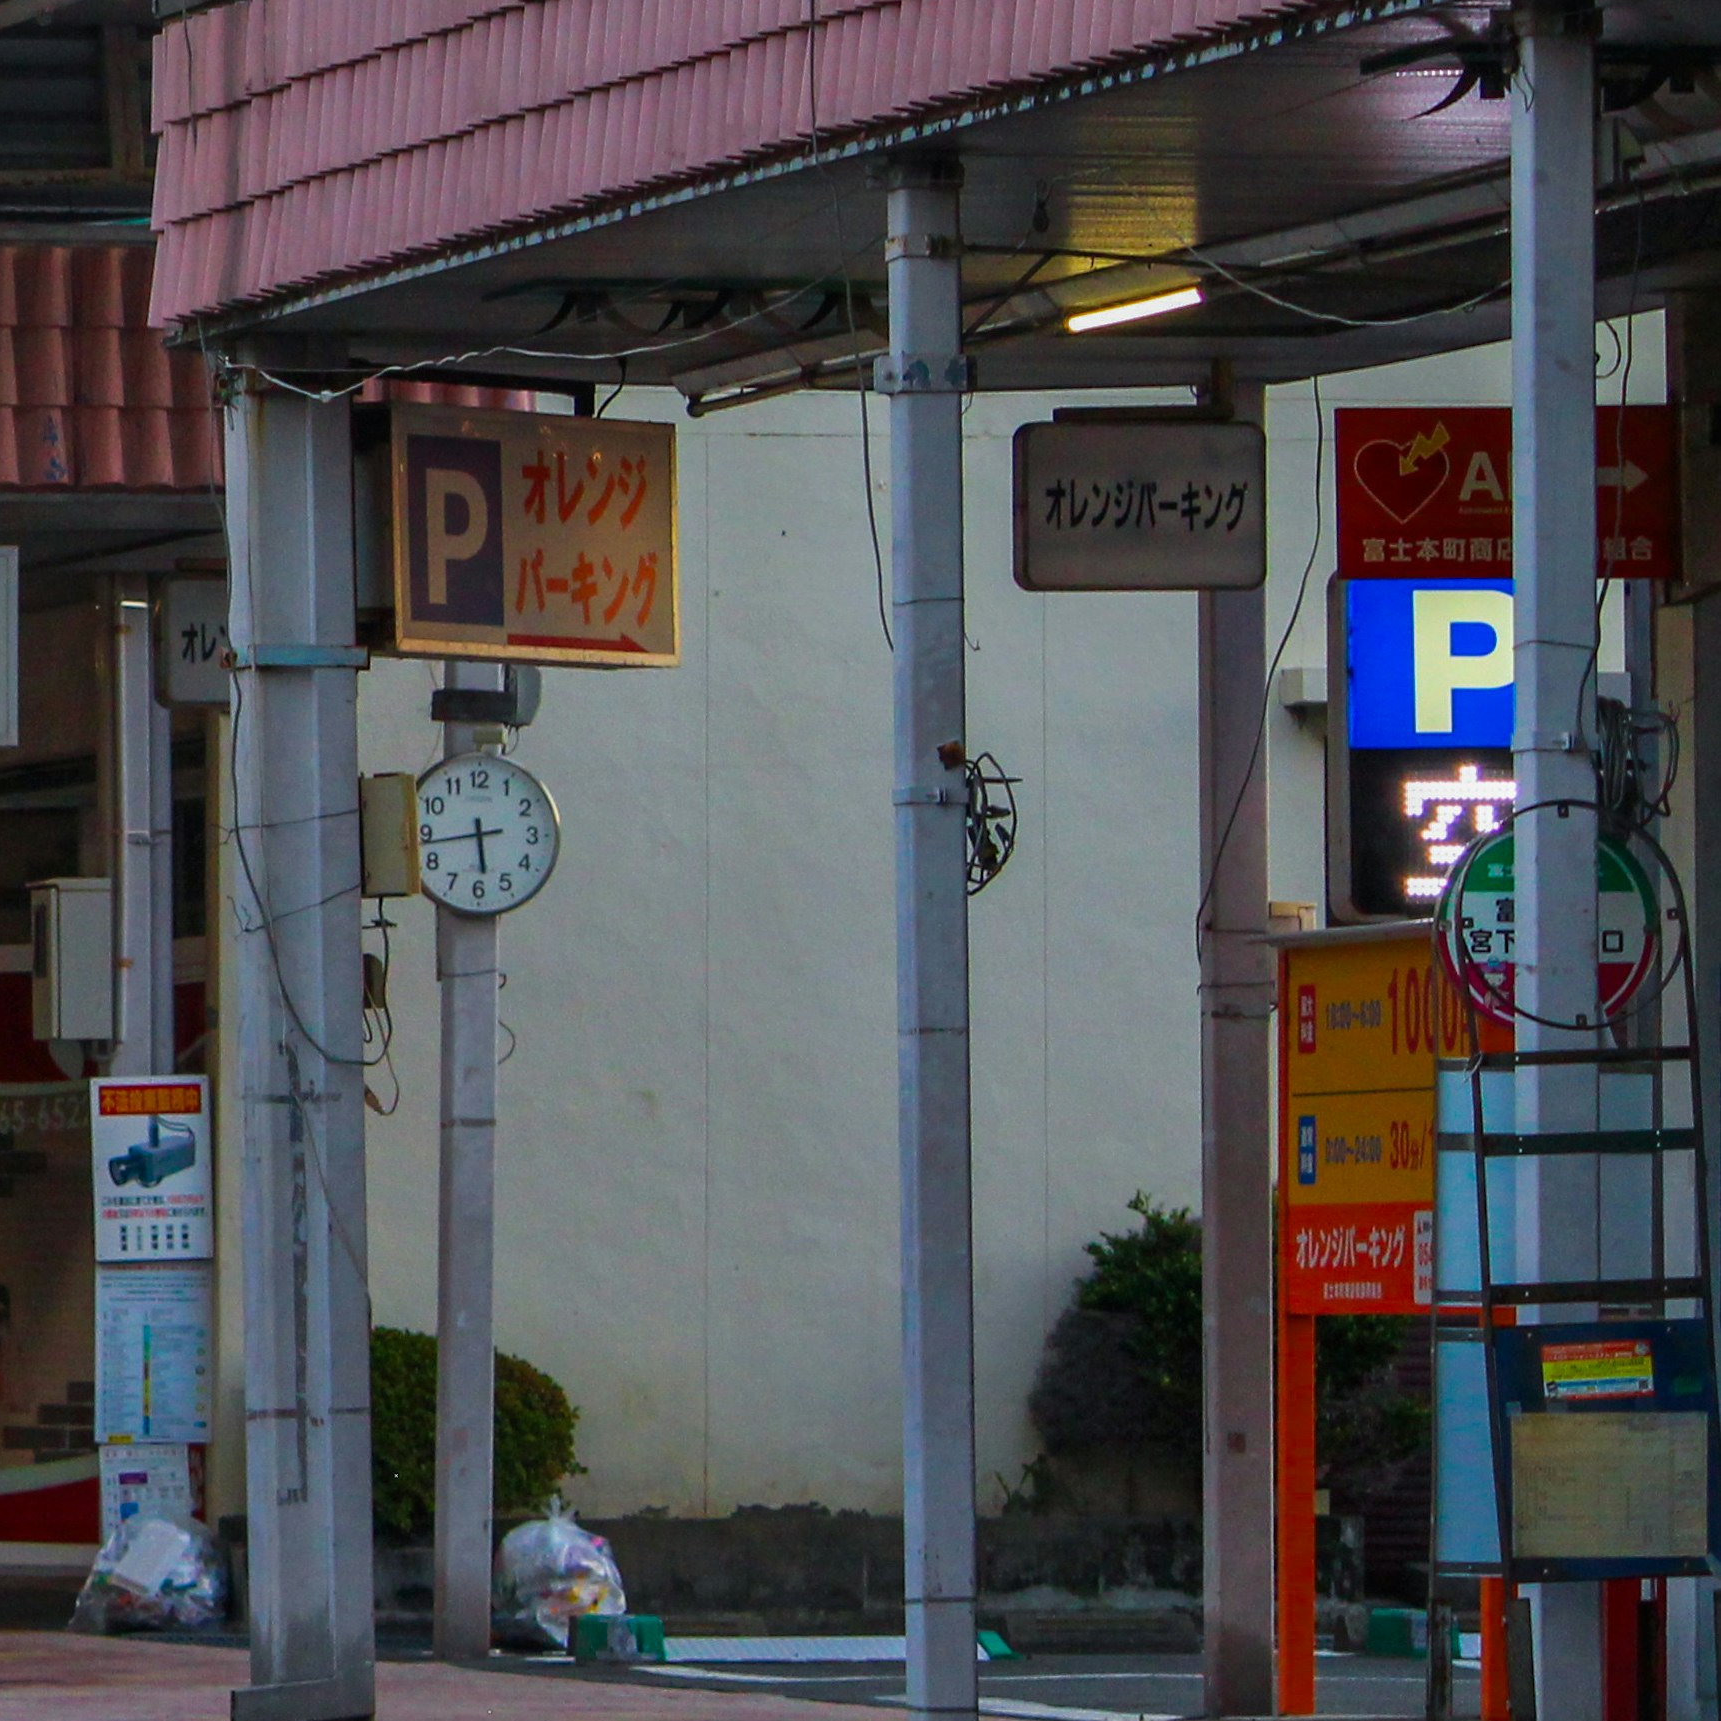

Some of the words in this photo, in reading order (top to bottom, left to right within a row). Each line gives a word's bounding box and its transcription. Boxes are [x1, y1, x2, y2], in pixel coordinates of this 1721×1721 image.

[522, 450, 647, 529] オレンジ
[1046, 479, 1248, 532] オレンジパーキング
[425, 468, 488, 605] P
[515, 548, 657, 628] パーキング
[181, 623, 227, 663] オレ
[1413, 590, 1514, 733] P
[447, 778, 460, 795] 11
[470, 770, 489, 788] 12
[503, 779, 510, 796] 1
[424, 797, 444, 815] 10
[519, 799, 531, 816] 2
[420, 824, 432, 842] 9
[526, 826, 538, 844] 3
[426, 852, 439, 870] 8
[519, 853, 530, 871] 4
[447, 872, 458, 890] 7
[473, 880, 485, 898] 6
[499, 873, 512, 890] 5
[1296, 1225, 1405, 1268] オレンジパーキング
